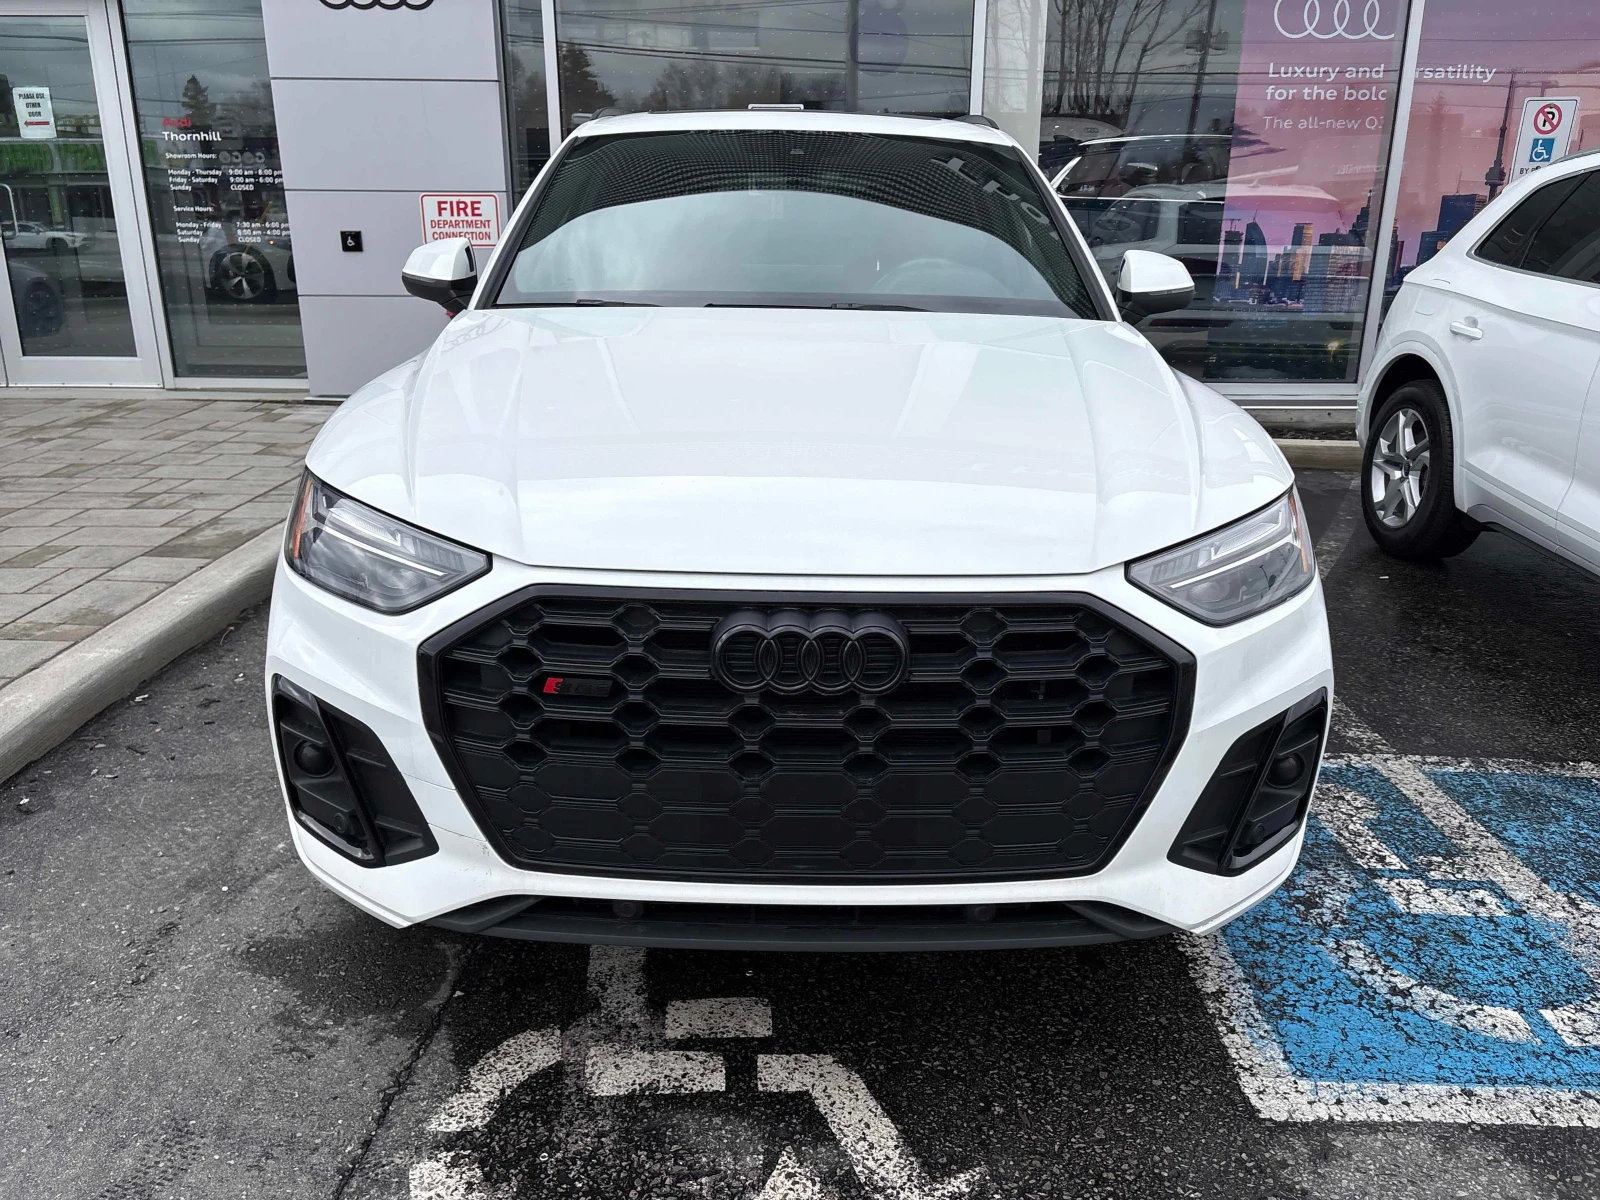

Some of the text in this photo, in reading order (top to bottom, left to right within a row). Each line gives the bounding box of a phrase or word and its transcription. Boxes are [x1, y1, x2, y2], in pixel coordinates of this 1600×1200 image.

[1268, 62, 1497, 83] Luxury and rsatility
[1265, 85, 1297, 100] for
[1302, 85, 1338, 101] the
[162, 116, 192, 128] Audi
[1262, 116, 1293, 130] The
[1298, 115, 1361, 130] all-new
[162, 131, 222, 141] Thornhill
[1520, 167, 1529, 175] BY
[437, 200, 482, 217] FIRE
[430, 219, 491, 229] DEPARTMENT
[432, 231, 491, 240] CONNECTION
